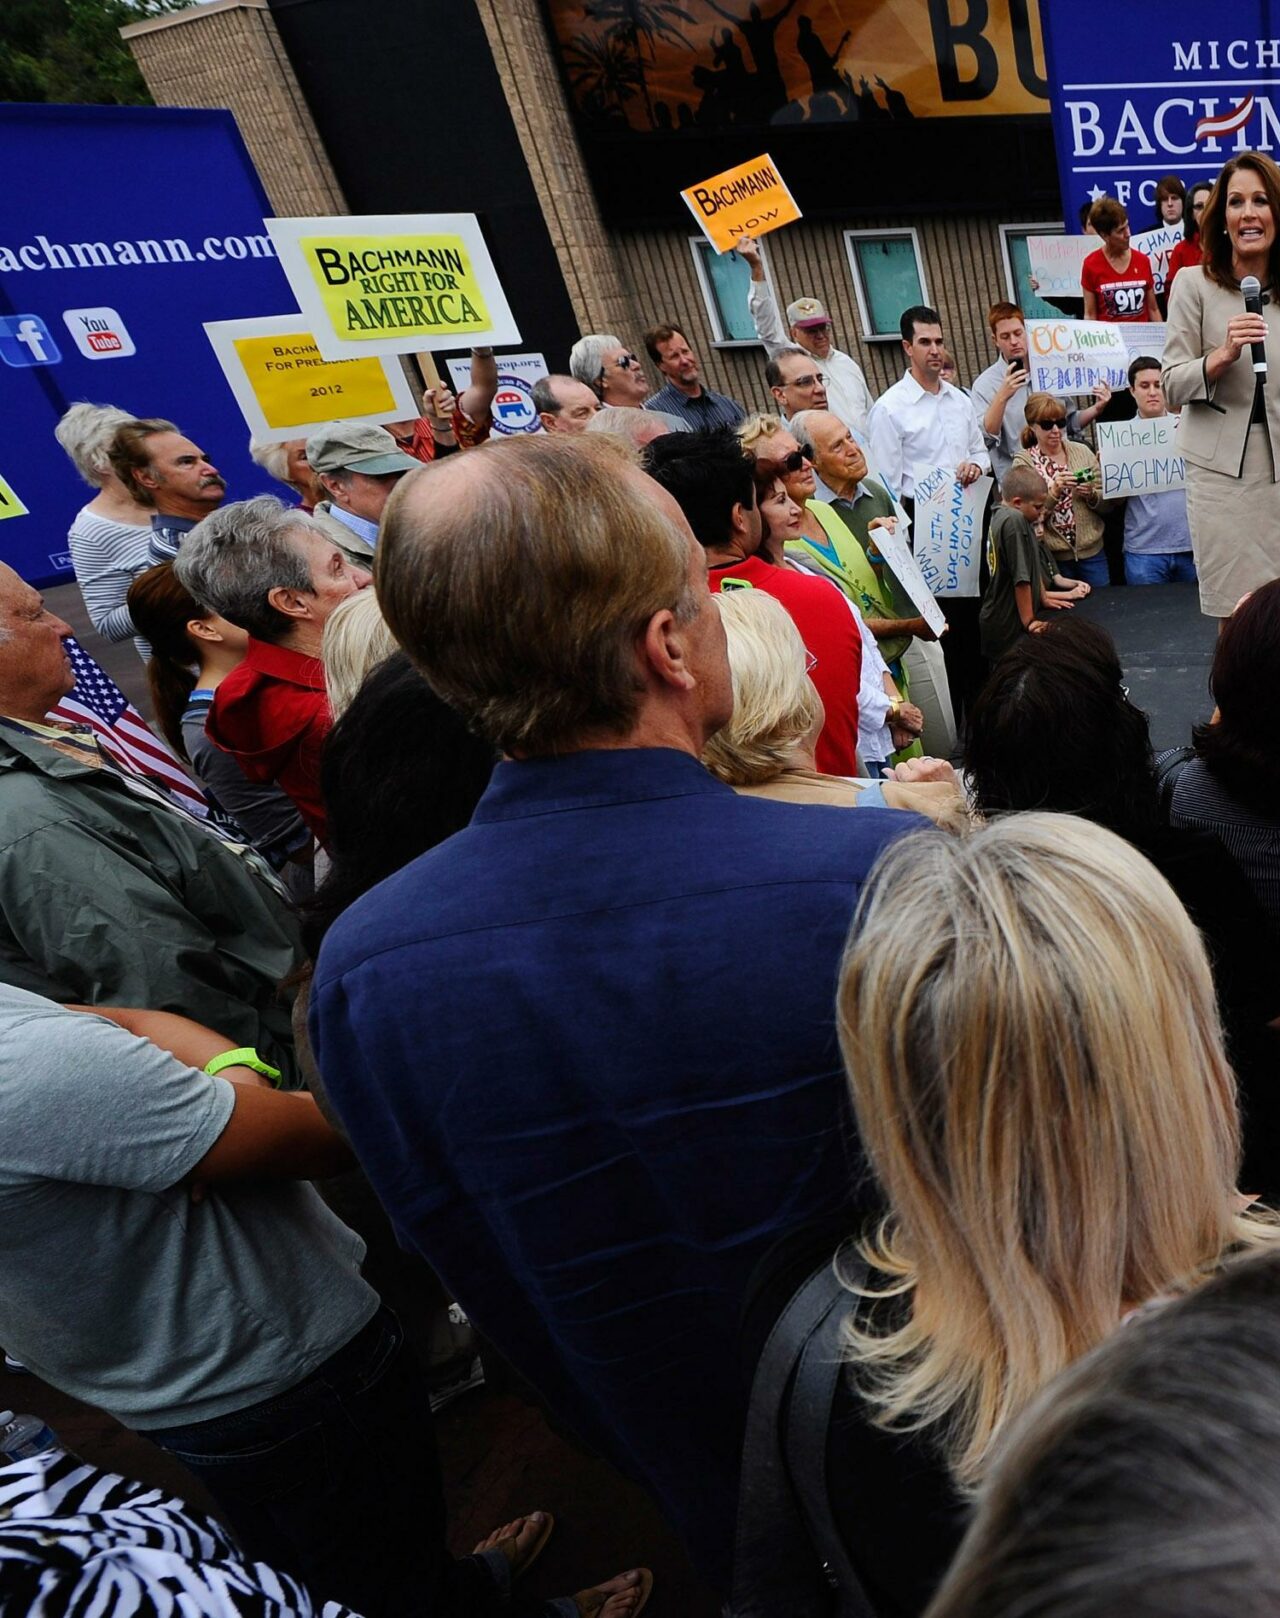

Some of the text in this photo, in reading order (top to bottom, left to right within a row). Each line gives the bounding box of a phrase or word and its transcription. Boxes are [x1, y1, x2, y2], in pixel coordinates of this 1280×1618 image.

[693, 167, 778, 216] BACHMANN
[1114, 180, 1186, 207] FO
[728, 208, 779, 236] NOW
[315, 248, 465, 285] BACHMANN
[359, 271, 461, 294] RIGHT FOR
[346, 293, 482, 331] AMERICA
[1115, 287, 1145, 312] 912
[79, 316, 109, 332] You
[88, 333, 122, 351] Tube
[1031, 325, 1073, 355] OC
[1074, 329, 1120, 348] Patriots
[265, 361, 293, 372] FOR
[1068, 353, 1085, 362] FOR
[310, 384, 344, 397] 2012
[1099, 422, 1168, 448] Michele
[930, 511, 943, 553] WITH
[960, 507, 975, 567] 2012
